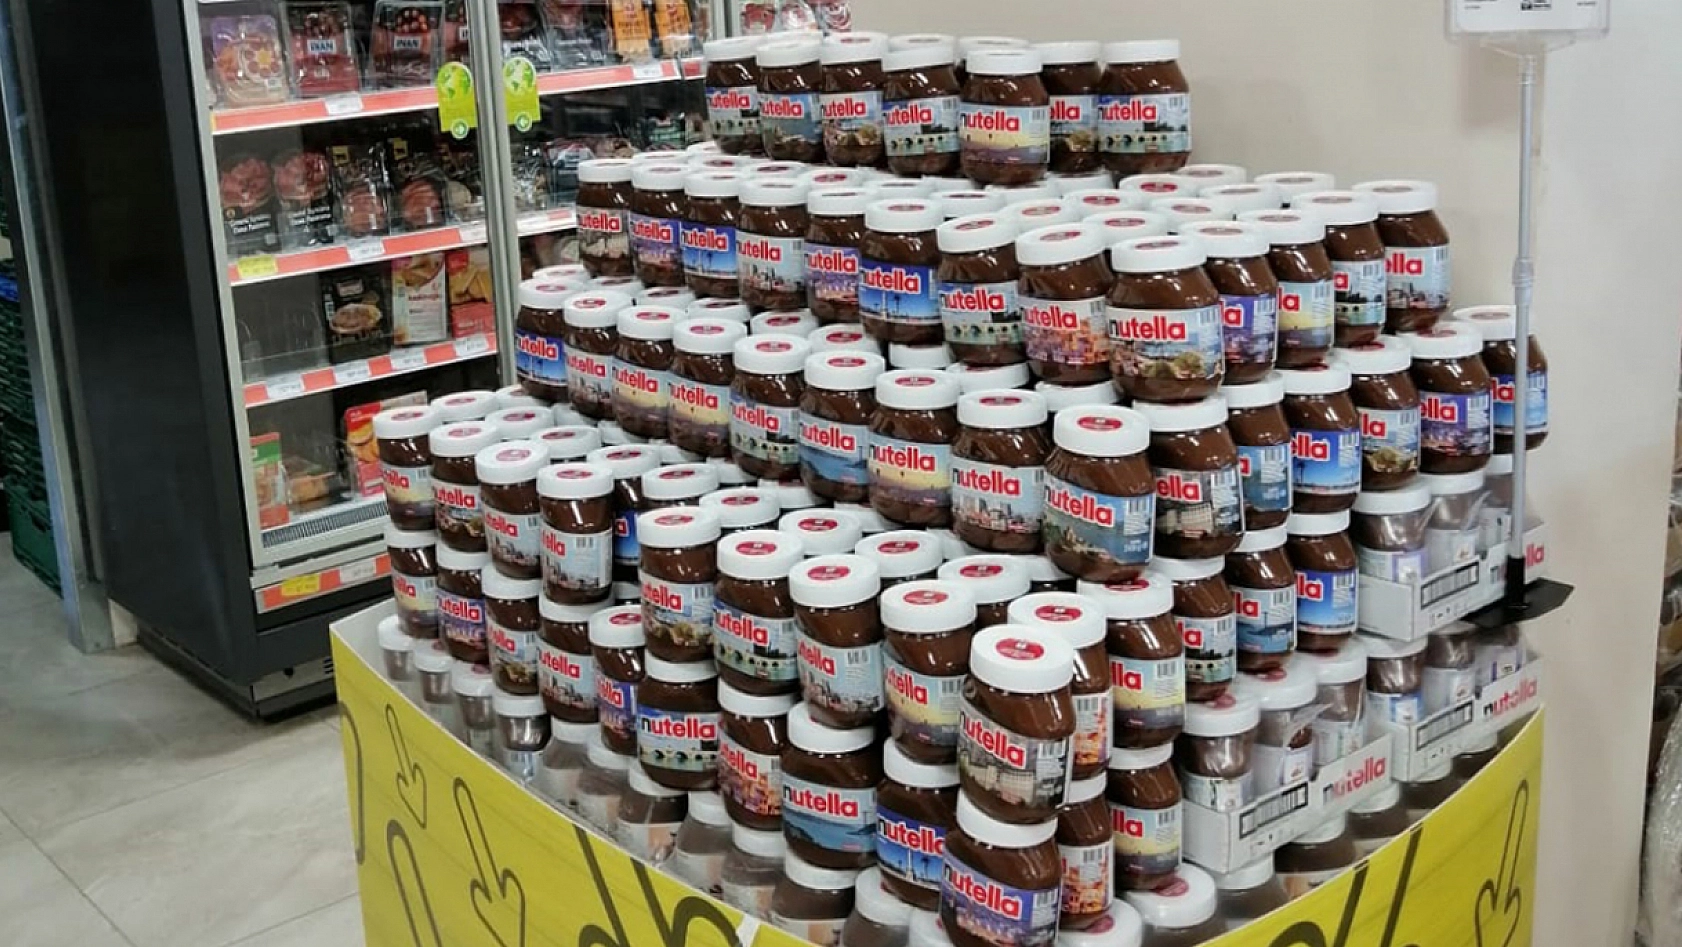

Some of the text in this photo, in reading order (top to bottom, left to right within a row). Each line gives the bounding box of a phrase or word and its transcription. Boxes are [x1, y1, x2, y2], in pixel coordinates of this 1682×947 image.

[1109, 316, 1186, 341] nutella
[641, 716, 716, 740] nutella
[784, 786, 859, 819] nutella
